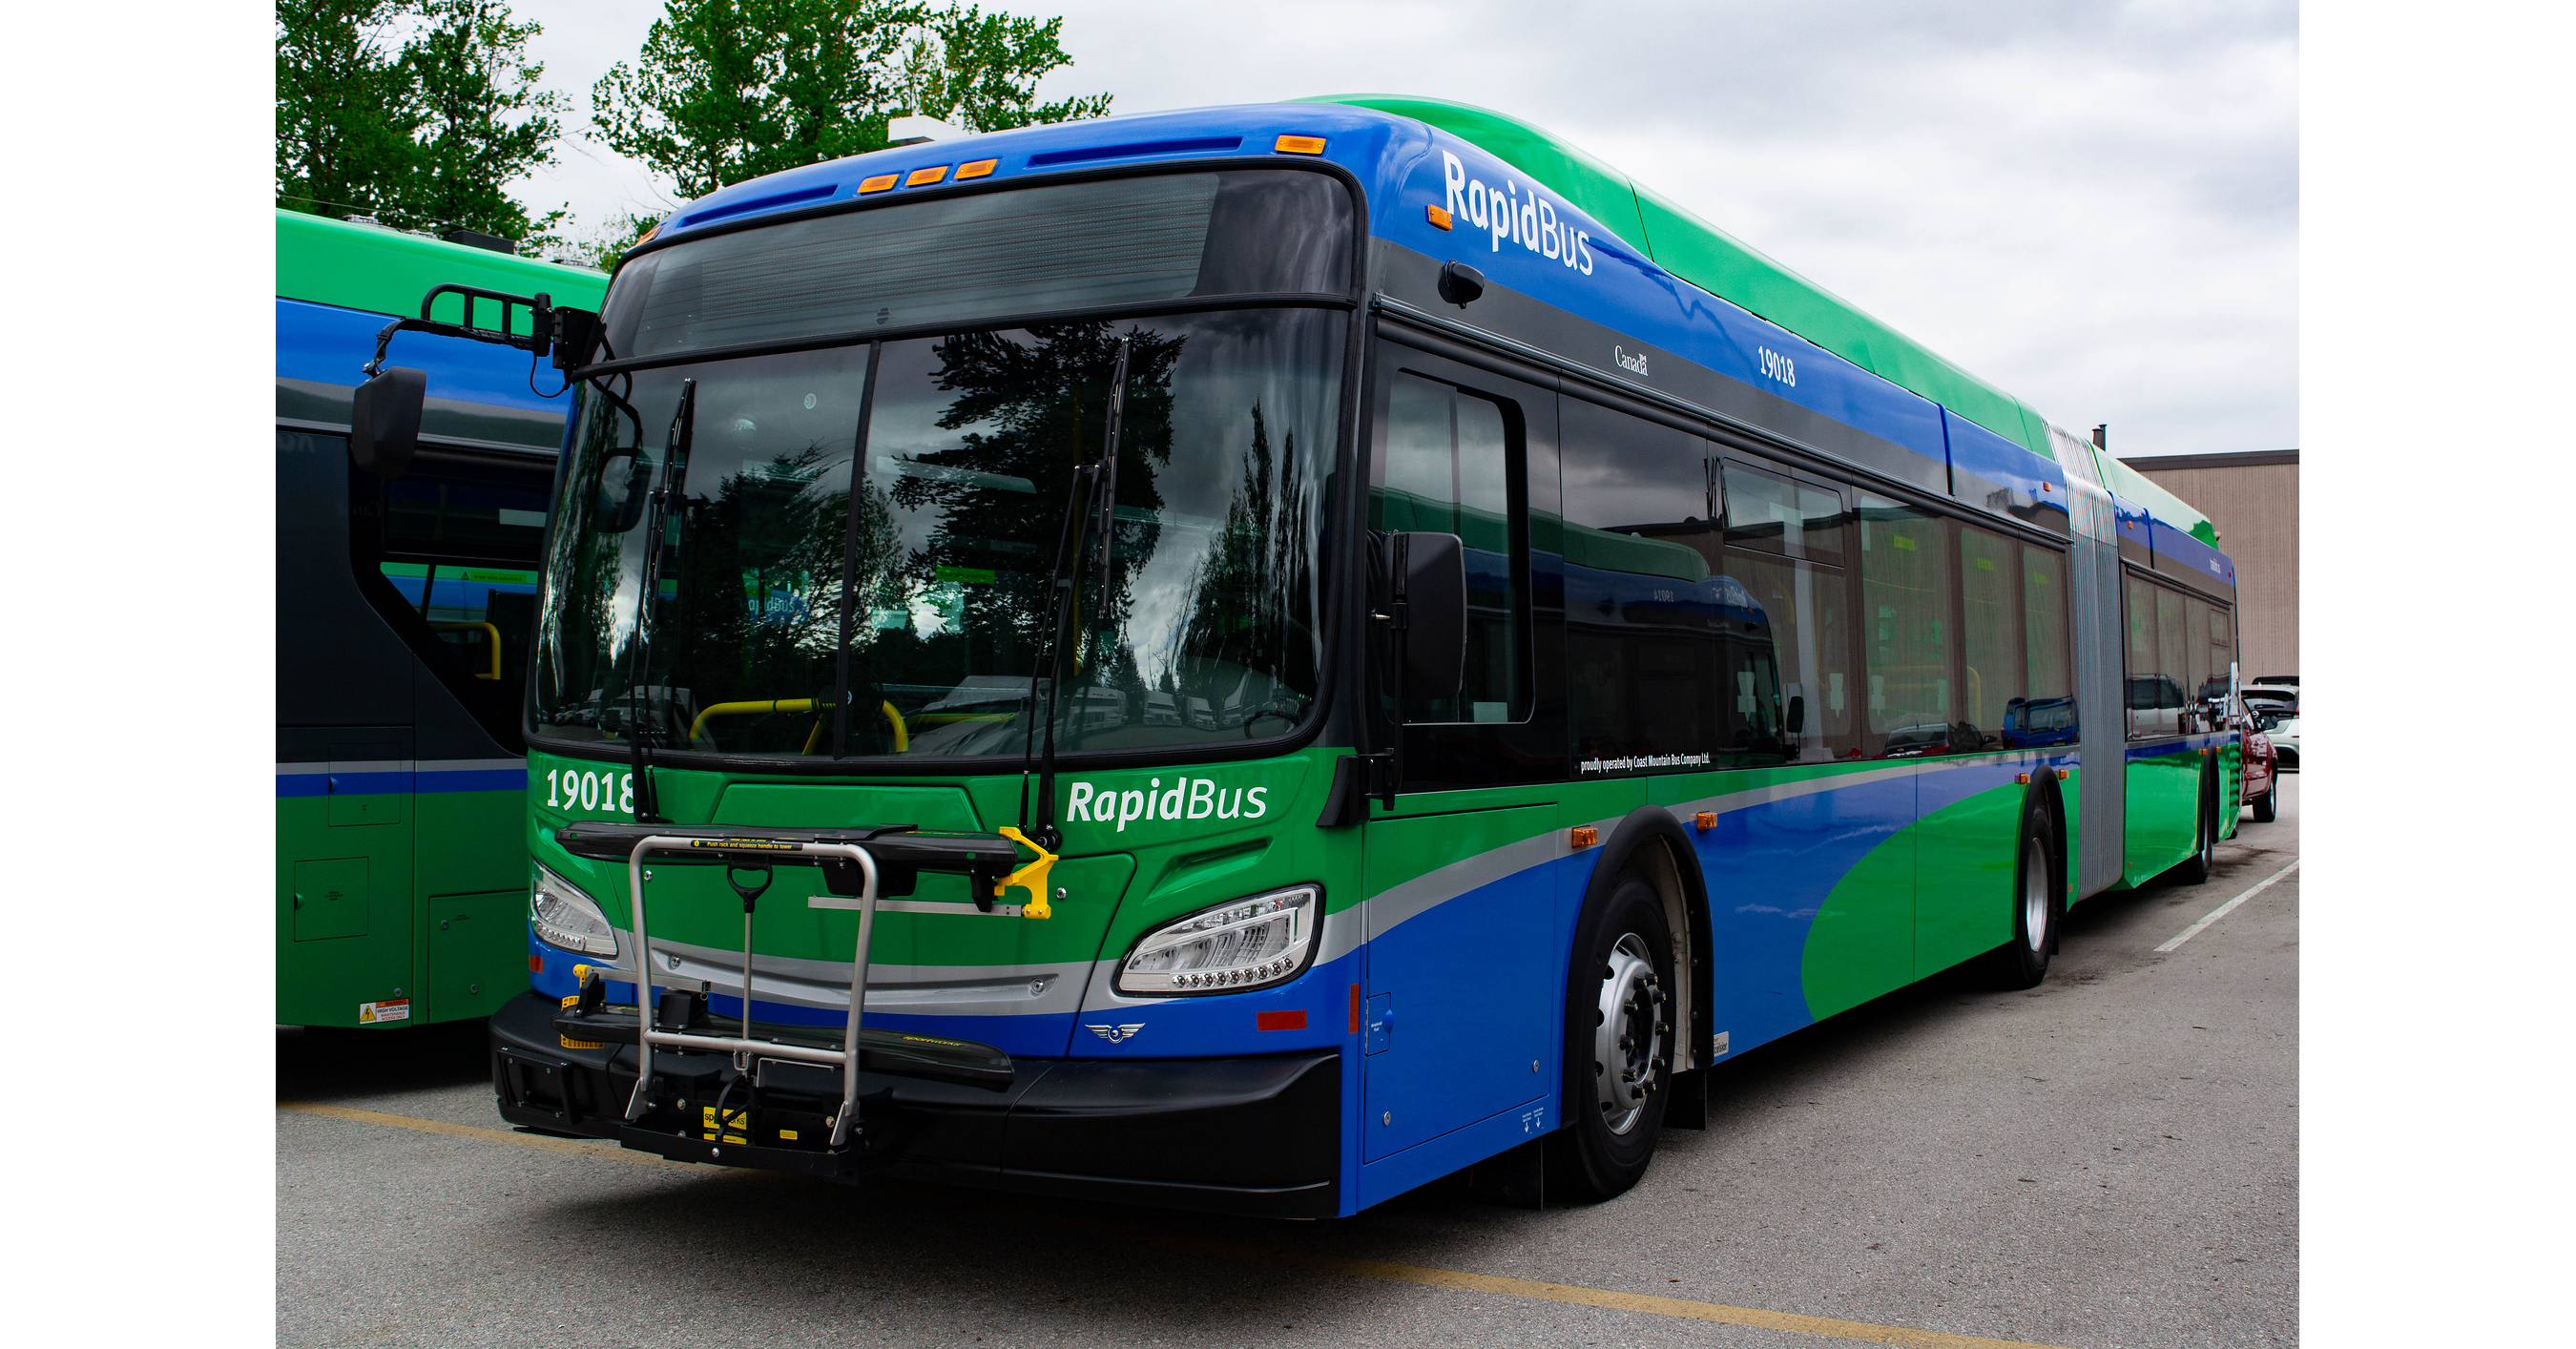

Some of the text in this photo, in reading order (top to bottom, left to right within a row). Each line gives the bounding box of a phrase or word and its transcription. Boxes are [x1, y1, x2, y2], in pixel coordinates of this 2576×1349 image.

[1443, 150, 1593, 277] RapidBus
[1614, 344, 1649, 377] Canada
[1758, 345, 1796, 387] 19018
[1580, 752, 1711, 775] proudly operated by Coast Mountain Bus Company Ltd.
[547, 769, 634, 814] 19018
[1067, 777, 1268, 833] RapidBus
